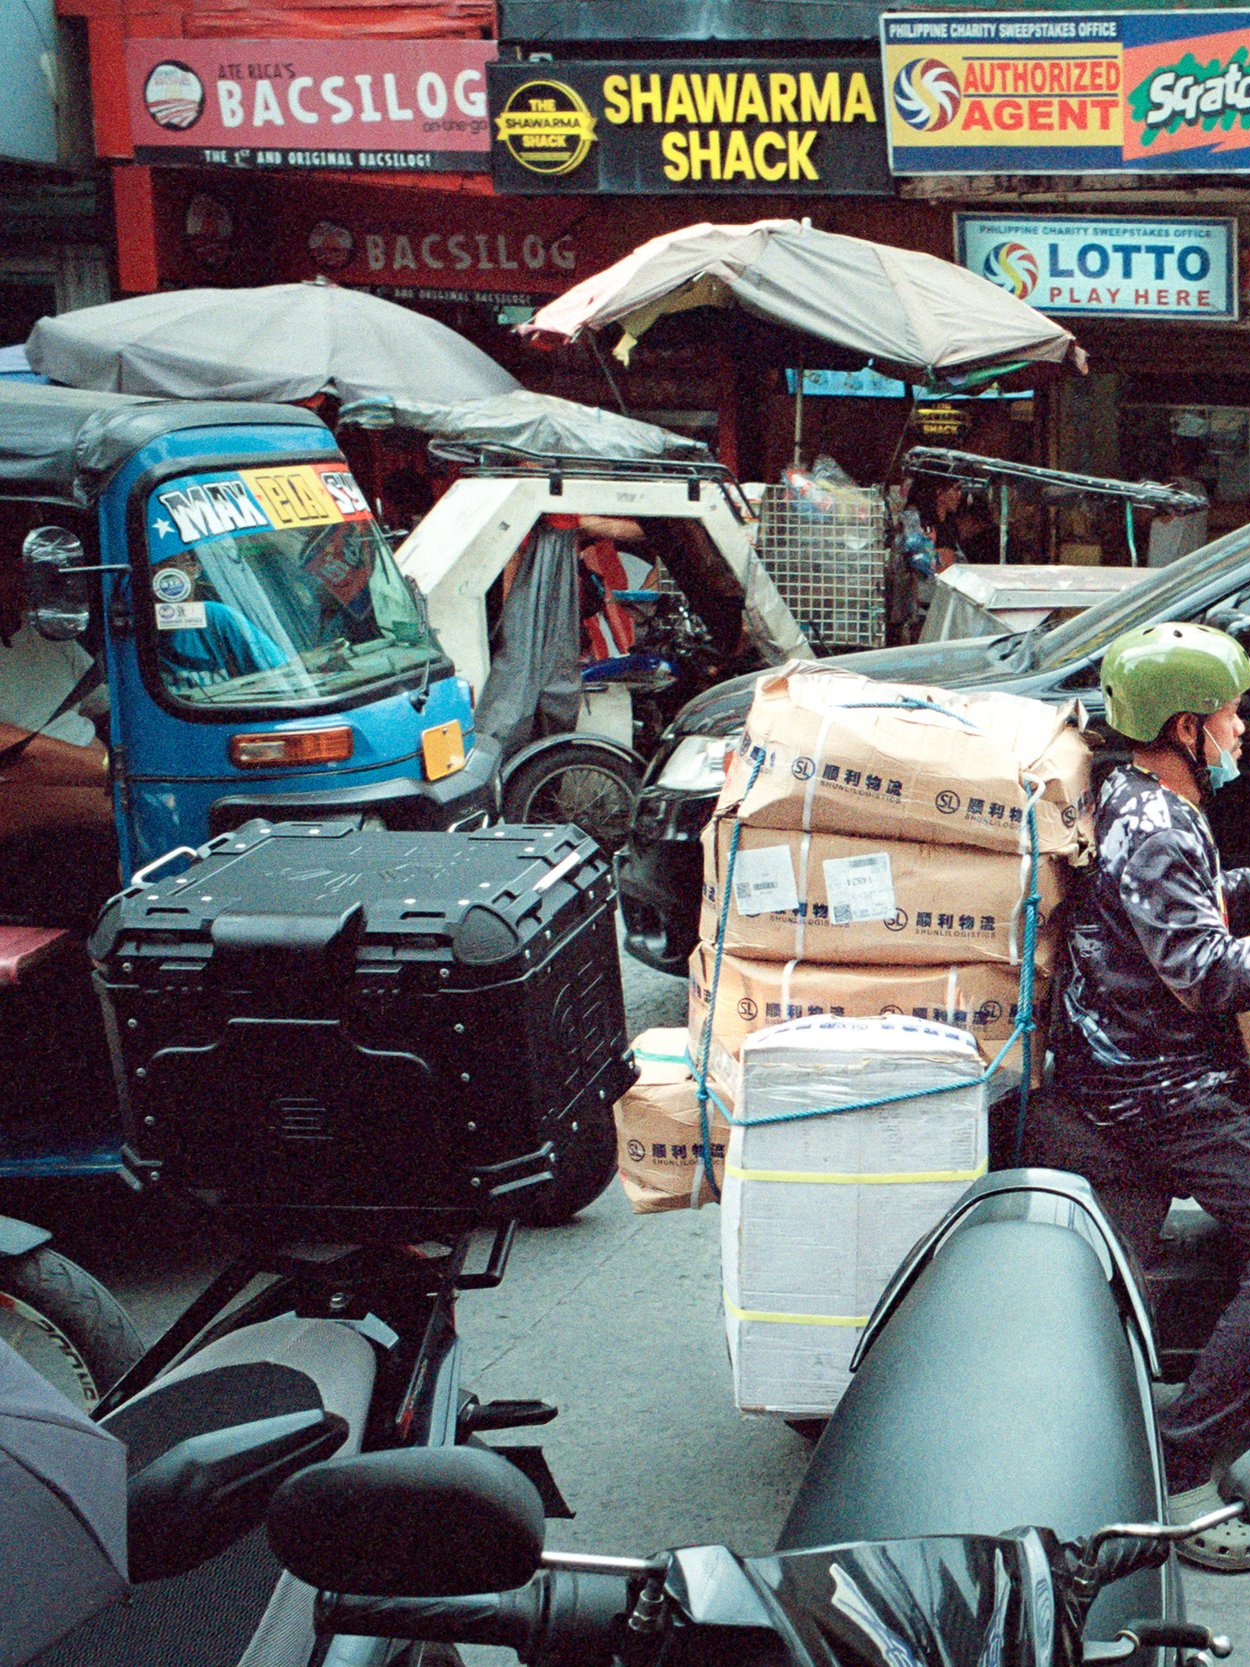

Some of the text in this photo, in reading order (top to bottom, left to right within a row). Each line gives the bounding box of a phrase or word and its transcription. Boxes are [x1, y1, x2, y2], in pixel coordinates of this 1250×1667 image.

[889, 22, 1117, 38] PHILIPPINE CHARITY SWEEPSTAKES OFFICE
[217, 63, 243, 80] ATE
[963, 60, 1121, 93] AUTHORIZED
[216, 69, 488, 128] BACSILOG
[528, 99, 556, 112] THE
[603, 72, 878, 124] SHAWARMA
[504, 116, 582, 130] SHAWARMA
[961, 99, 1120, 131] AGENT
[522, 134, 567, 148] SHACK
[204, 149, 227, 164] THE
[256, 151, 282, 166] AND
[288, 152, 353, 167] ORIGINAL
[662, 130, 820, 183] SHACK
[979, 225, 1212, 239] PHILIPPINE CHARITY SWEEPSTAKES OFFICE
[364, 233, 577, 271] BACSILOG
[1048, 242, 1212, 282] LOTTO
[1049, 287, 1212, 307] PLAY HERE
[159, 480, 270, 544] MAX
